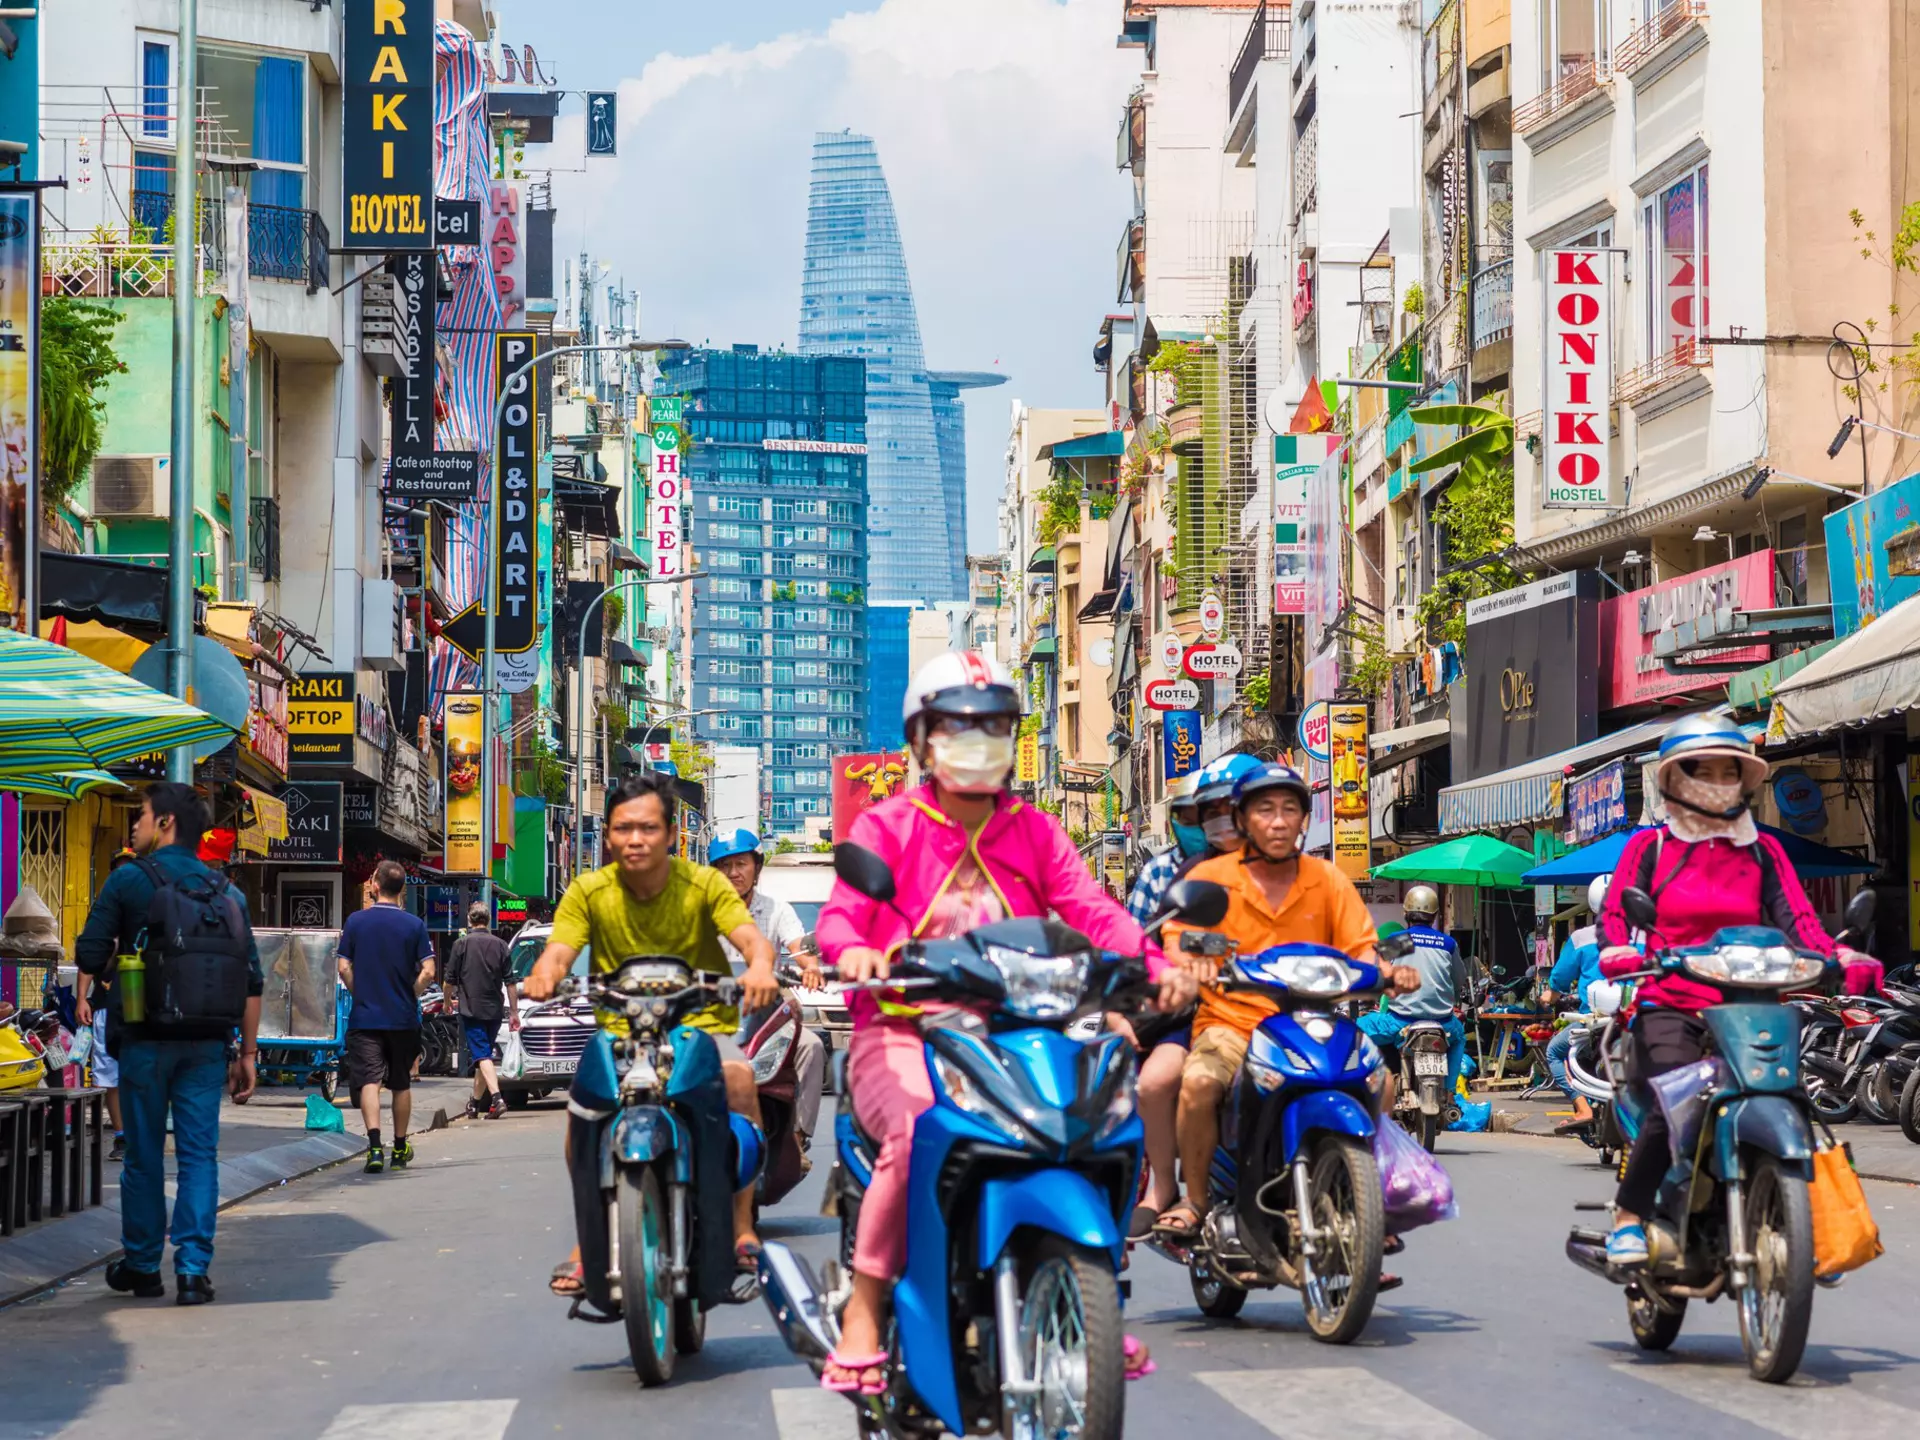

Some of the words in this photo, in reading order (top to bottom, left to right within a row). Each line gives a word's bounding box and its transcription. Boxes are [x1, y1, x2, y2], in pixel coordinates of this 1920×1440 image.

[350, 194, 426, 234] HOTEL
[1554, 252, 1604, 486] KONIKO
[660, 399, 673, 409] VN
[652, 409, 680, 421] PEARL
[656, 430, 676, 445] 94
[835, 442, 867, 454] LAND
[395, 456, 418, 468] Cafe
[419, 460, 432, 469] on
[433, 456, 473, 472] Rooftop
[424, 470, 444, 479] and
[396, 478, 472, 491] Restaurant
[1550, 487, 1607, 502] HOSTEL
[656, 454, 678, 576] HOTEL
[1194, 656, 1239, 665] HOTEL
[497, 670, 510, 678] Egg
[512, 670, 535, 678] Coffee
[1215, 672, 1228, 680] 131
[1155, 689, 1195, 698] HOTEL
[293, 742, 341, 753] restaurant
